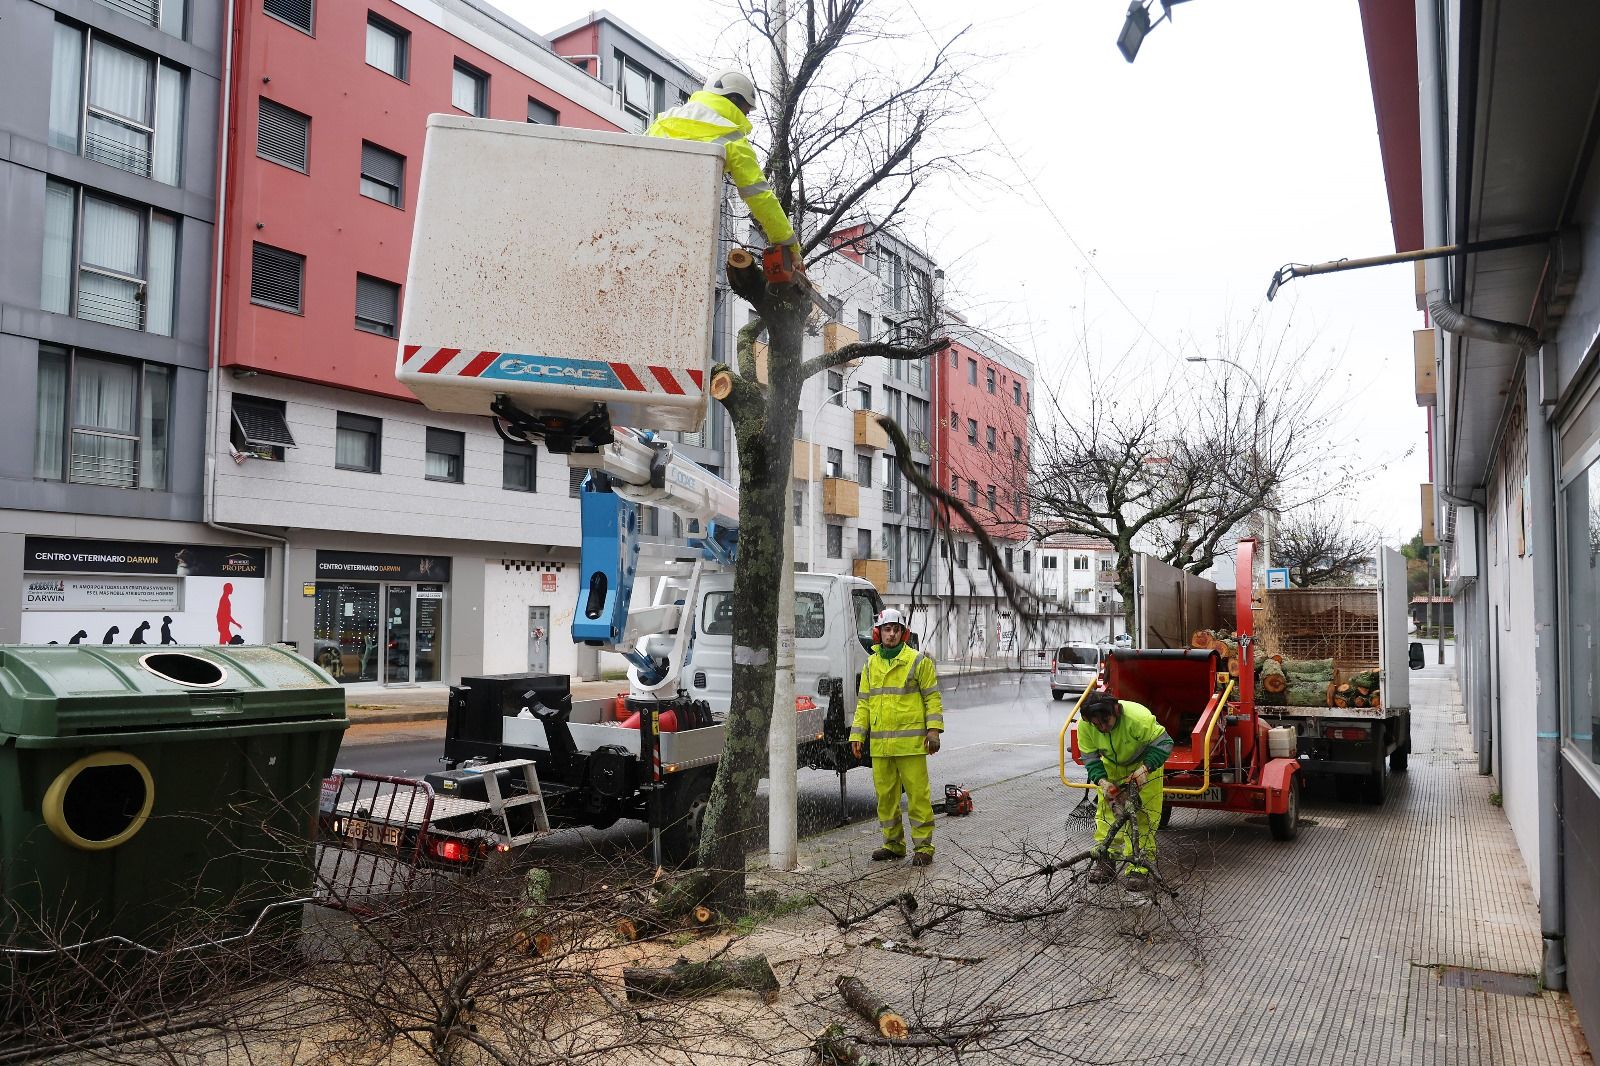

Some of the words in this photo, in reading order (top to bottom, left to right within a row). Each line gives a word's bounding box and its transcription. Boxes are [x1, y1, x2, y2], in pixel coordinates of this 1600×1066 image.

[35, 552, 71, 561] CENTRO
[72, 553, 126, 563] VETERINARIO
[127, 556, 159, 564] DARWIN
[27, 594, 65, 602] DARWIN
